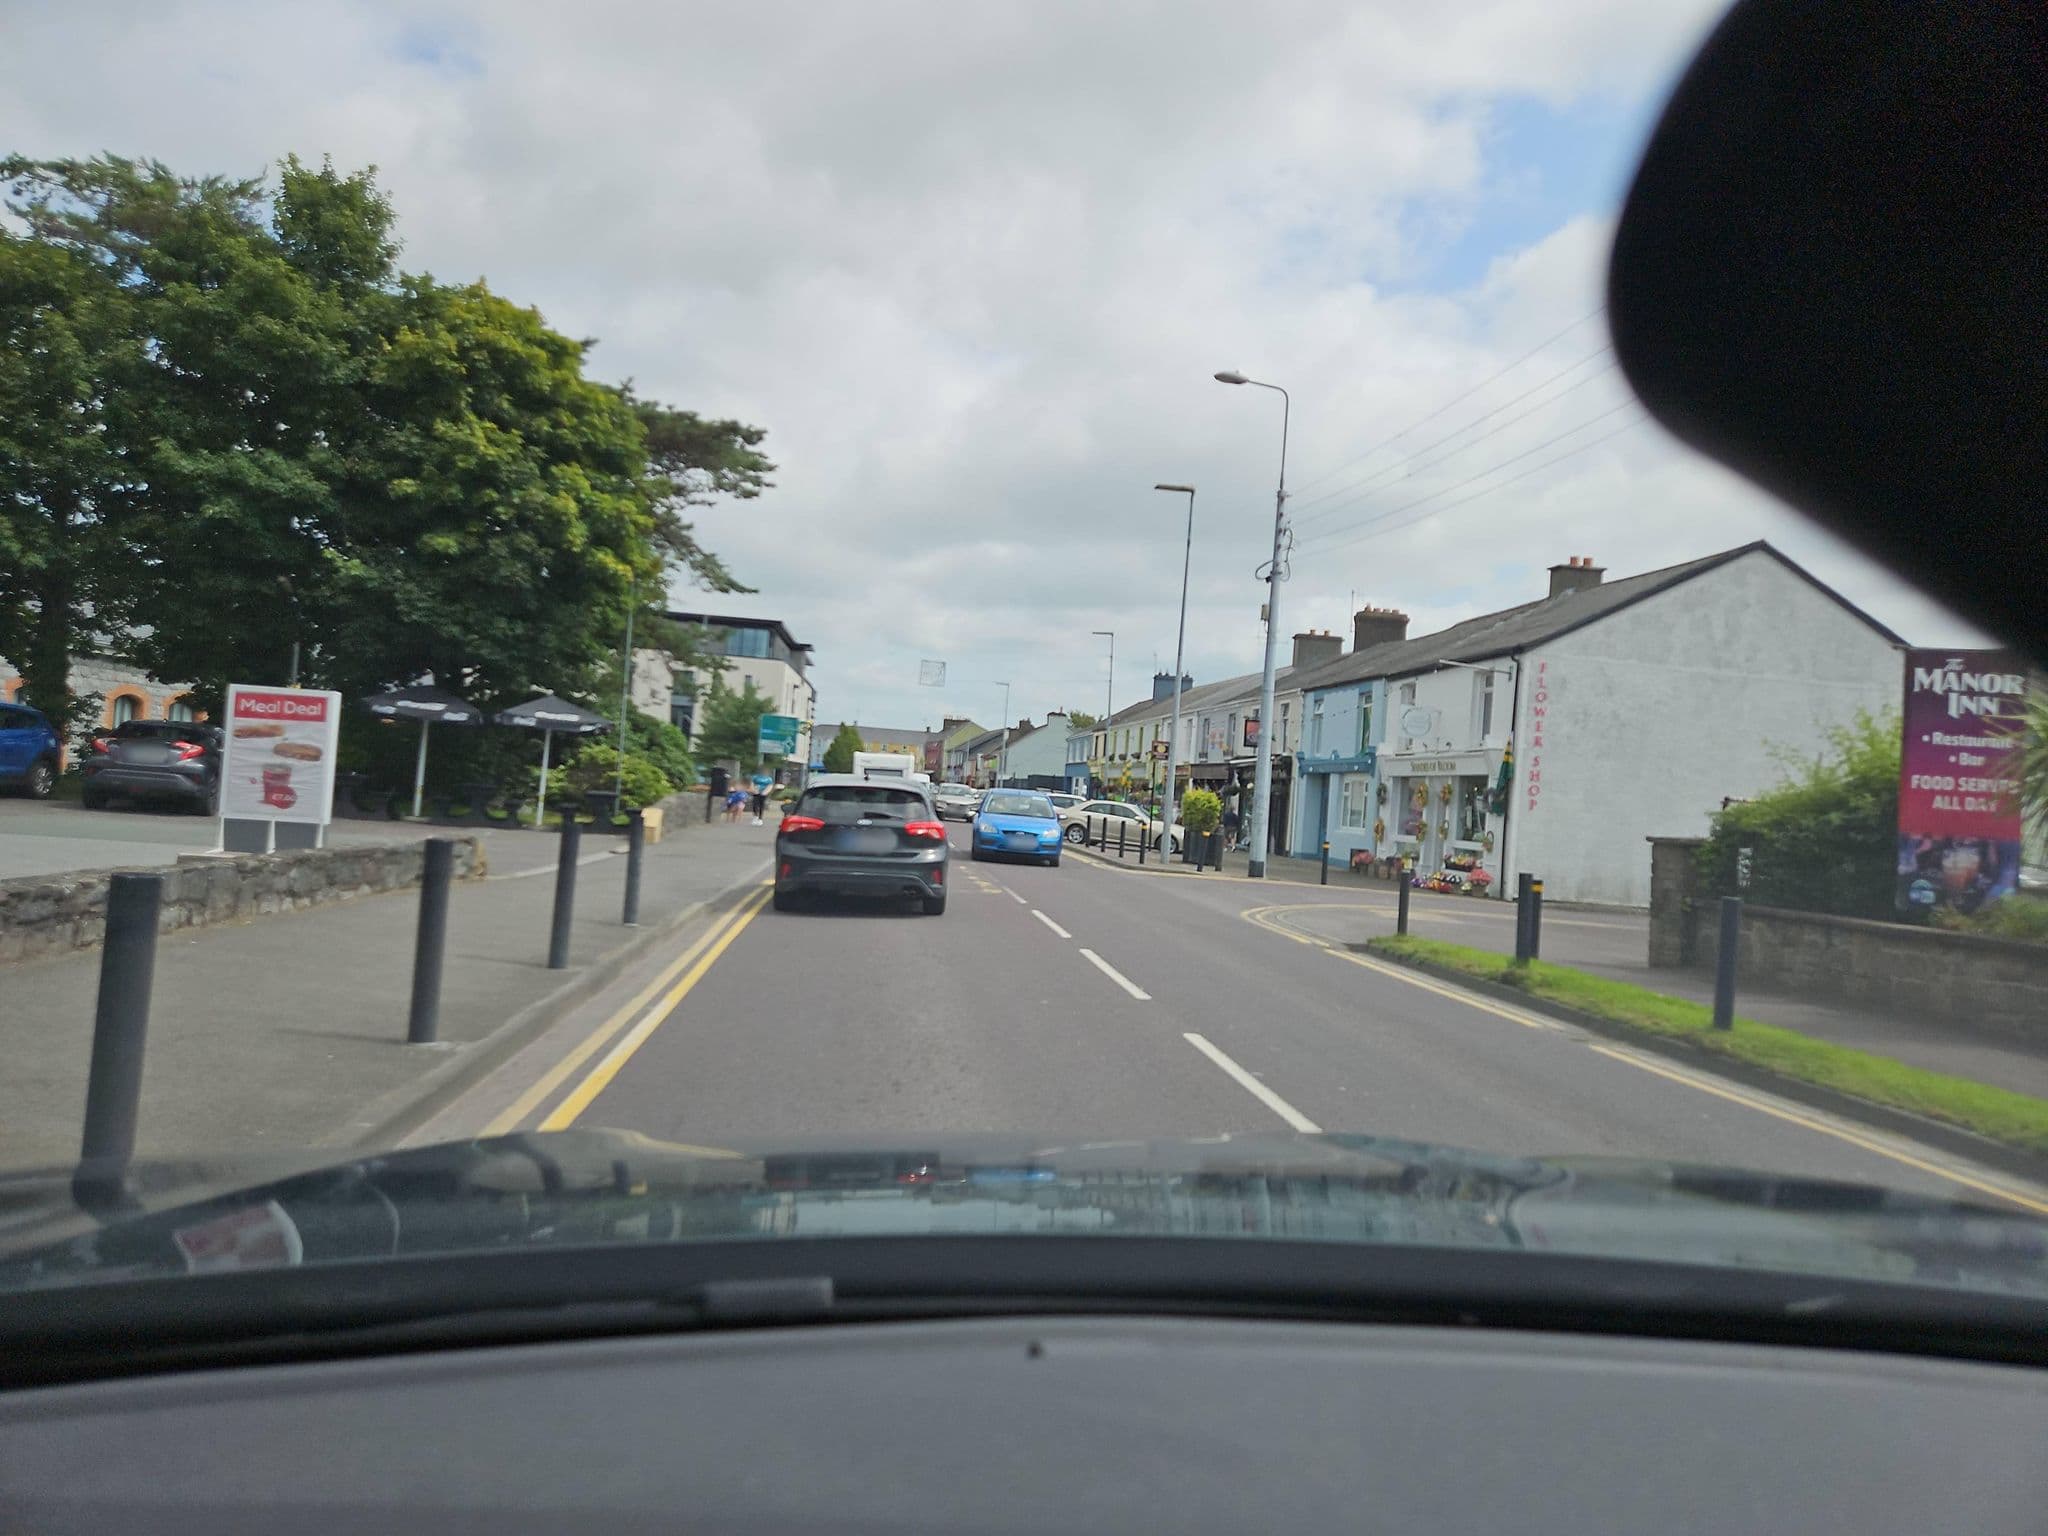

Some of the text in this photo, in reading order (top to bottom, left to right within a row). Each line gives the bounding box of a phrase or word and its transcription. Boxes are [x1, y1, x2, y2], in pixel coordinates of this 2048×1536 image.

[1913, 667, 2025, 695] MANOR
[240, 698, 322, 715] Meal Deal
[1533, 661, 1548, 747] FLOWER
[1947, 692, 2000, 719] INN
[1959, 752, 1986, 767] Bar
[1527, 756, 1541, 811] SHOP
[1911, 774, 1955, 791] FOOD
[1932, 795, 1961, 811] ALL
